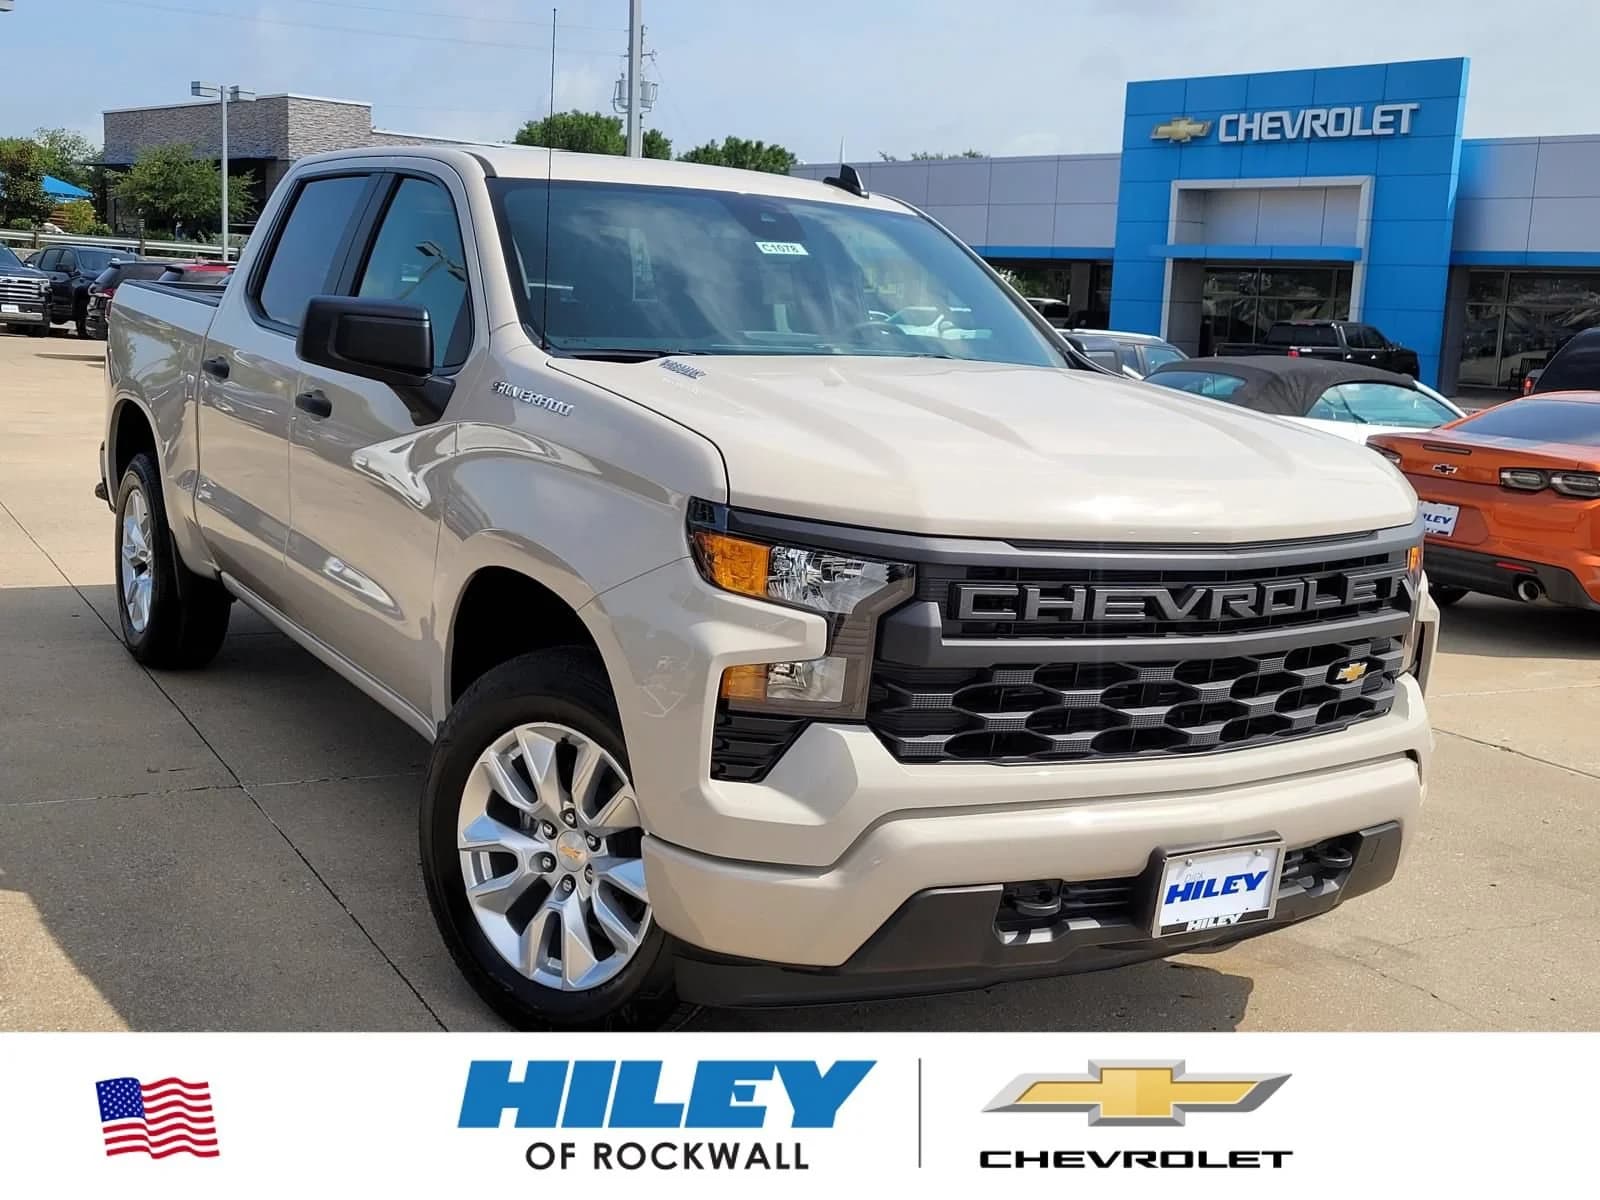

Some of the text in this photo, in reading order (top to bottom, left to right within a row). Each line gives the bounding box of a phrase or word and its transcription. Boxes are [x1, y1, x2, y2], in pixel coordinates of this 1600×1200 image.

[1218, 102, 1420, 143] CHEVROLET
[1423, 512, 1452, 525] ILEY
[1164, 870, 1269, 905] HILEY
[1187, 913, 1243, 932] HILEY
